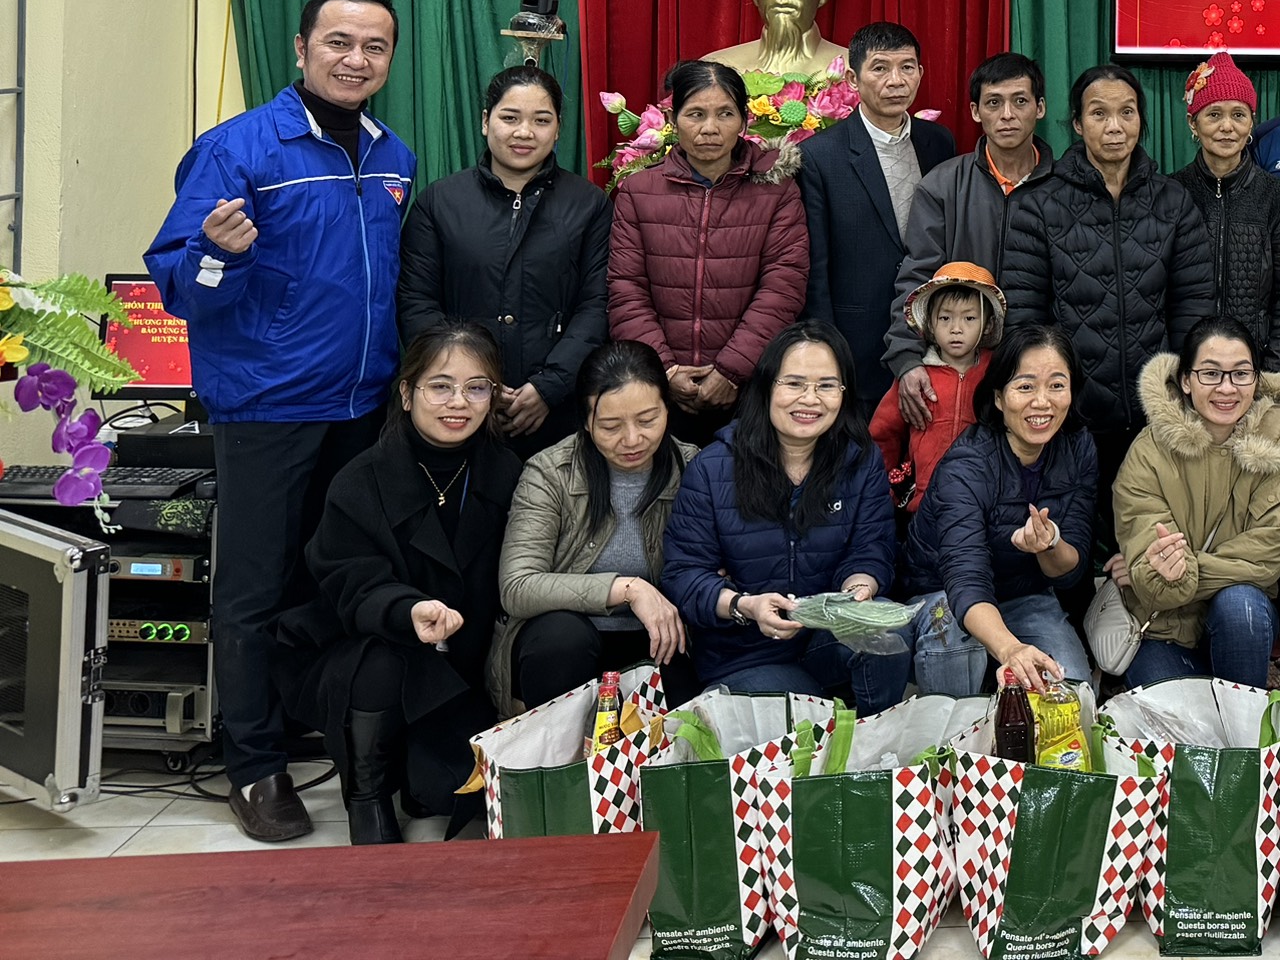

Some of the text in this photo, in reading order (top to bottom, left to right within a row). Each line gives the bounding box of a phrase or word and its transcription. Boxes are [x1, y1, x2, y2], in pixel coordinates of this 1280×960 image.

[121, 300, 144, 309] HÓM
[133, 318, 161, 326] HƯƠNG
[1169, 911, 1201, 920] Pensate
[1215, 912, 1254, 920] ambiente.
[696, 924, 738, 937] ambiente.
[1177, 921, 1246, 931] Questa borsa può
[1000, 930, 1032, 942] Pensate
[846, 938, 887, 948] ambiente.
[1006, 943, 1034, 951] Questa
[1035, 942, 1055, 950] borsa
[807, 946, 835, 957] Questa
[861, 951, 878, 959] può
[1003, 952, 1030, 960] essere
